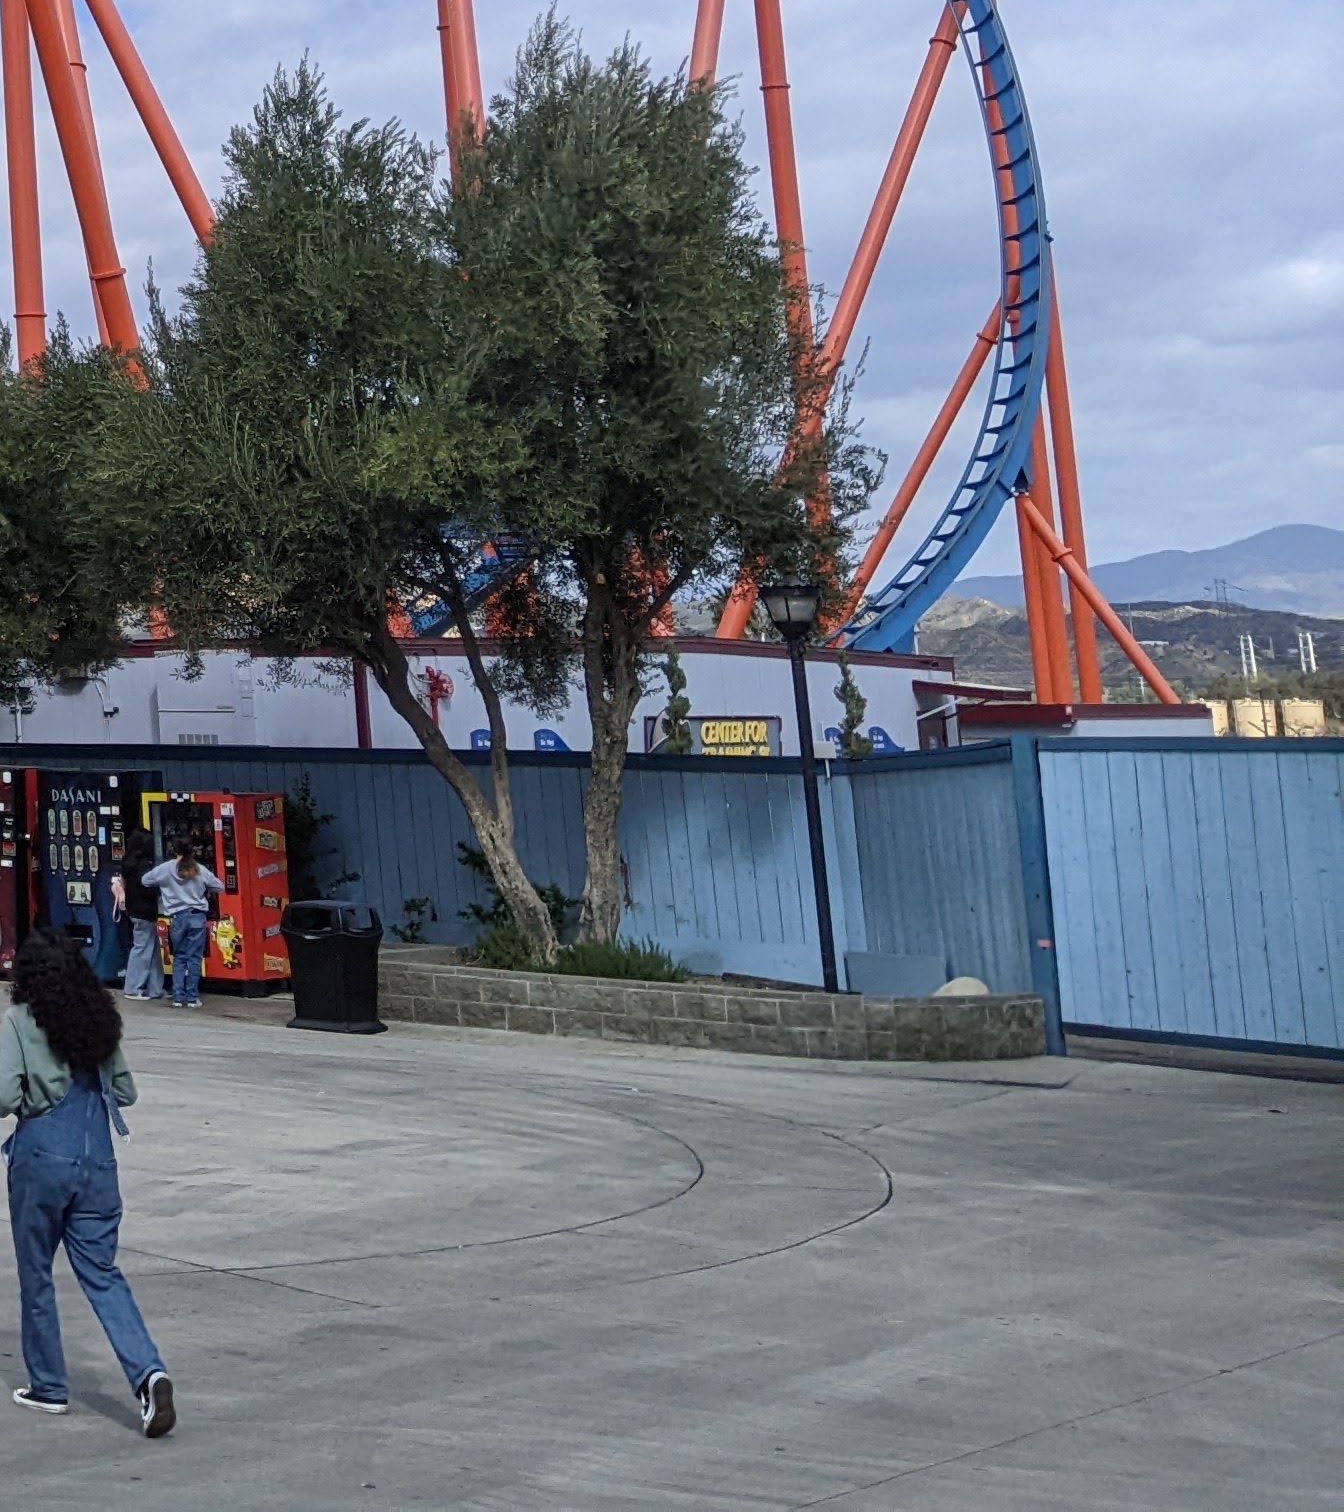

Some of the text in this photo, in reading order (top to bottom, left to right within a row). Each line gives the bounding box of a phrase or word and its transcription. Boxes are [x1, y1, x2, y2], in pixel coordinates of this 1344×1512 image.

[701, 721, 768, 744] CENTER FOR
[51, 787, 102, 805] DASANI
